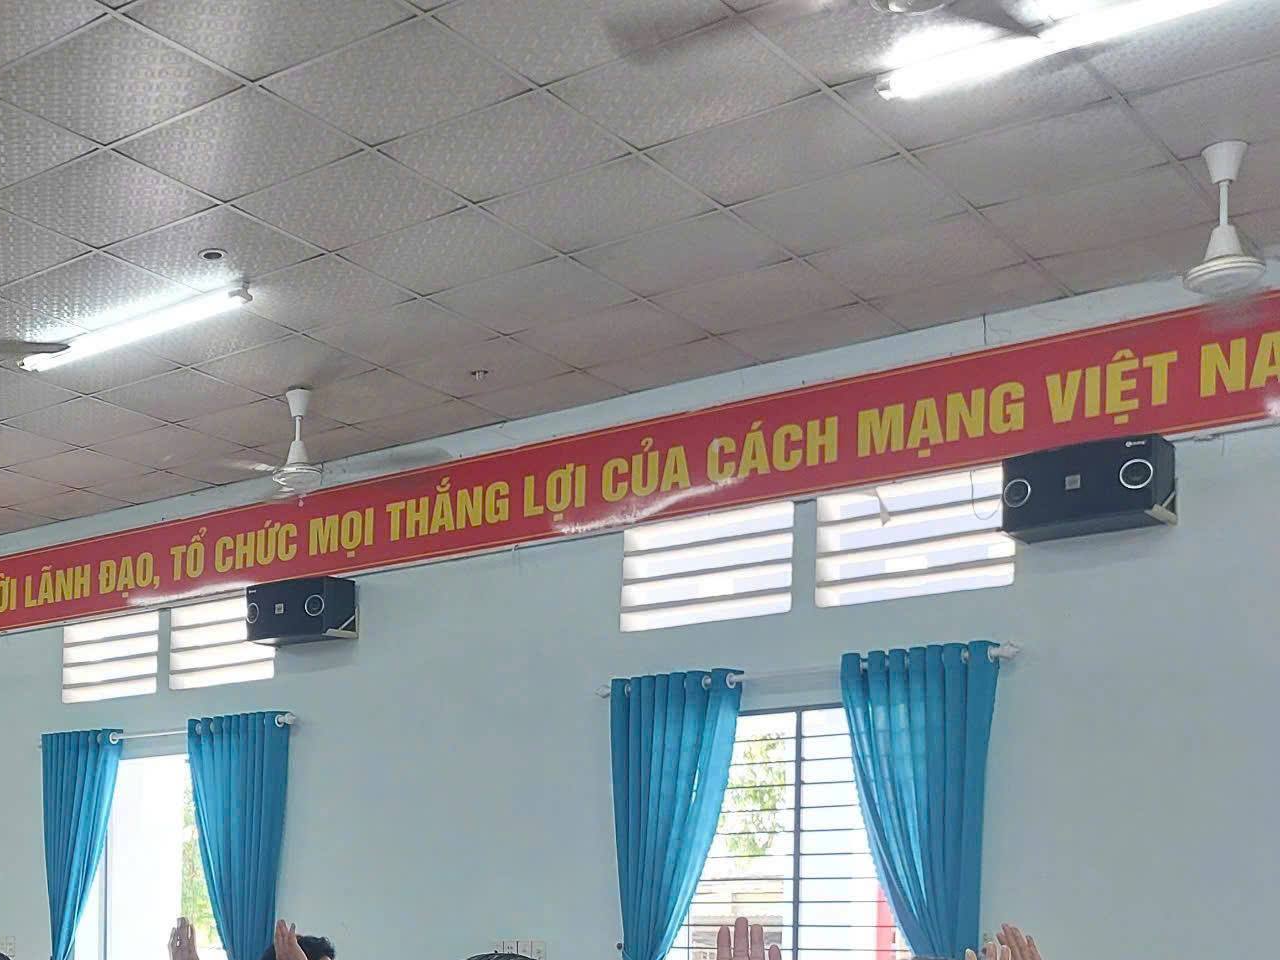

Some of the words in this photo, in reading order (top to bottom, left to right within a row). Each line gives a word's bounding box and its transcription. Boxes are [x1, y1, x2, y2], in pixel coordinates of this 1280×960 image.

[24, 564, 92, 609] LÃNH
[97, 551, 160, 599] ĐẠO,
[170, 525, 207, 581] TỔ
[214, 516, 299, 574] CHỨC
[308, 508, 375, 559] MỌI
[385, 476, 511, 541] THẮNG
[523, 463, 588, 523] LỢI
[601, 437, 692, 502] CỦA
[706, 415, 840, 484] CÁCH
[857, 381, 1027, 459] MẠNG
[1045, 348, 1179, 425] VIỆT
